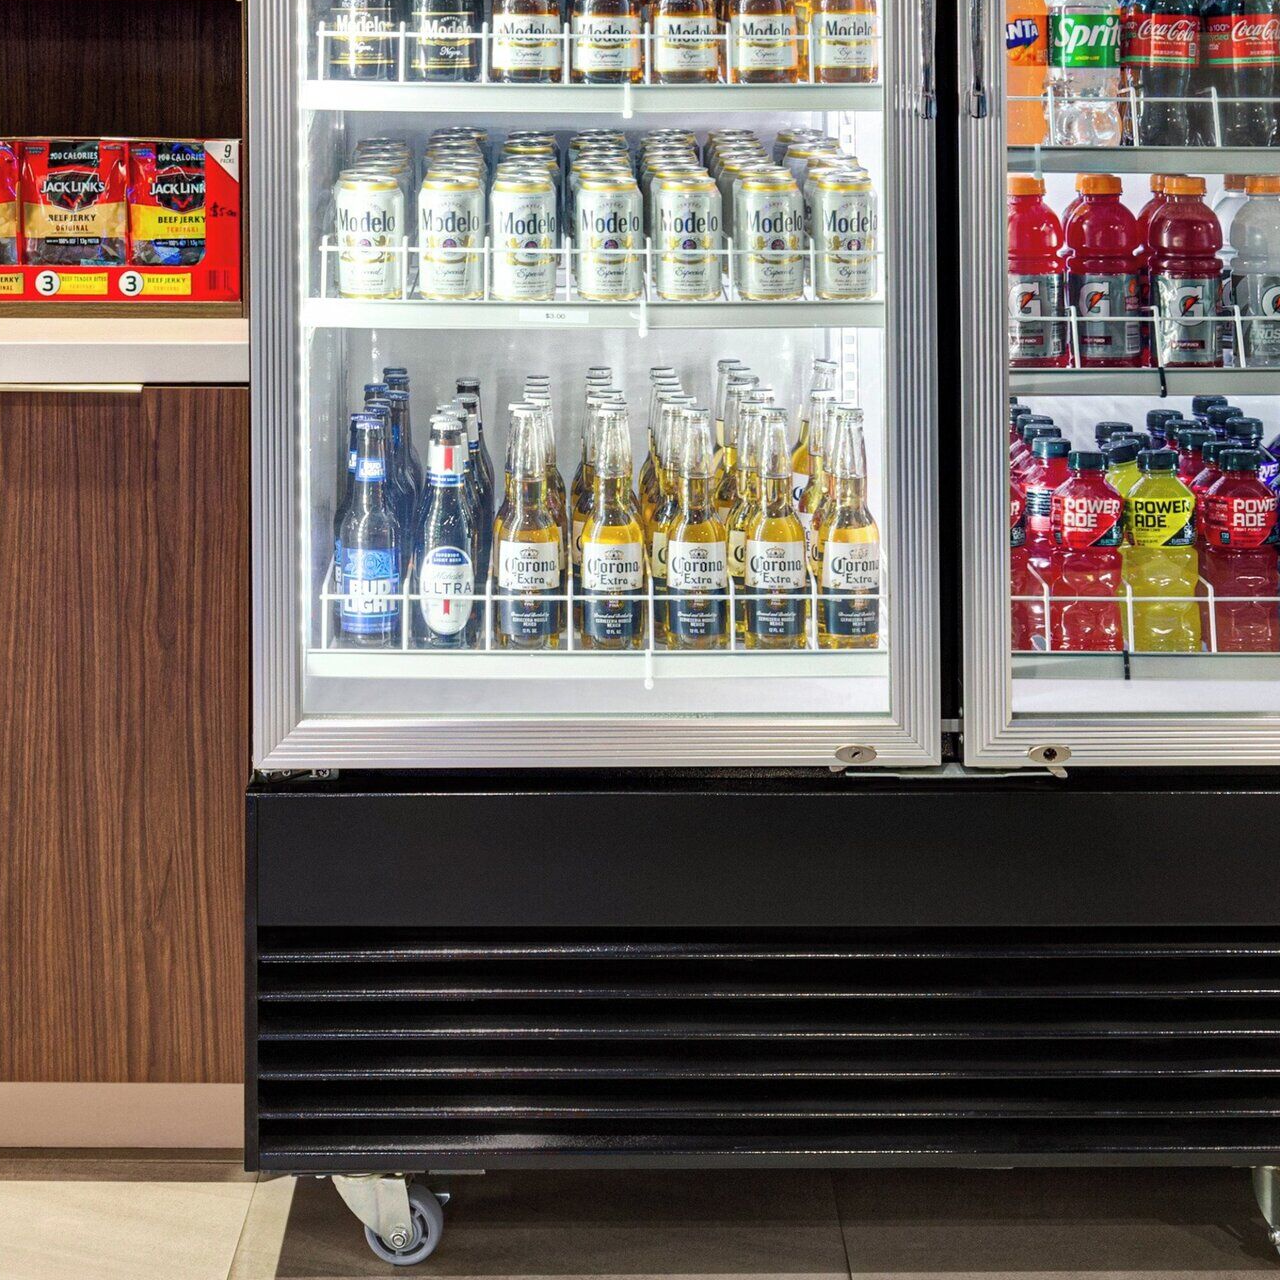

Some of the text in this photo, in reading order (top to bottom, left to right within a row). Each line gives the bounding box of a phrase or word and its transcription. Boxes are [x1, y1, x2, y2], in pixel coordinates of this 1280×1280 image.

[1138, 19, 1194, 42] Coca-Cola
[65, 151, 98, 160] CALORIES
[224, 145, 231, 157] 9
[42, 181, 69, 194] JACK
[150, 182, 179, 195] JACK
[49, 214, 96, 223] BEEF JERKY
[499, 210, 556, 235] Modelo
[747, 210, 803, 232] Modelo
[824, 210, 877, 232] Modelo
[42, 276, 54, 292] 3
[125, 276, 137, 292] 3
[1172, 287, 1204, 326] G
[1065, 498, 1120, 515] POWER
[1135, 500, 1190, 513] POWER
[1135, 514, 1166, 528] ADE
[1233, 514, 1266, 527] ADE
[505, 558, 556, 574] Corona
[672, 557, 723, 574] Corona
[751, 556, 801, 573] Corona
[352, 579, 390, 594] BUD
[513, 575, 544, 585] Extra
[684, 575, 712, 585] Extra
[763, 575, 791, 584] Extra
[846, 575, 872, 585] Extra
[344, 599, 397, 614] LIGHT
